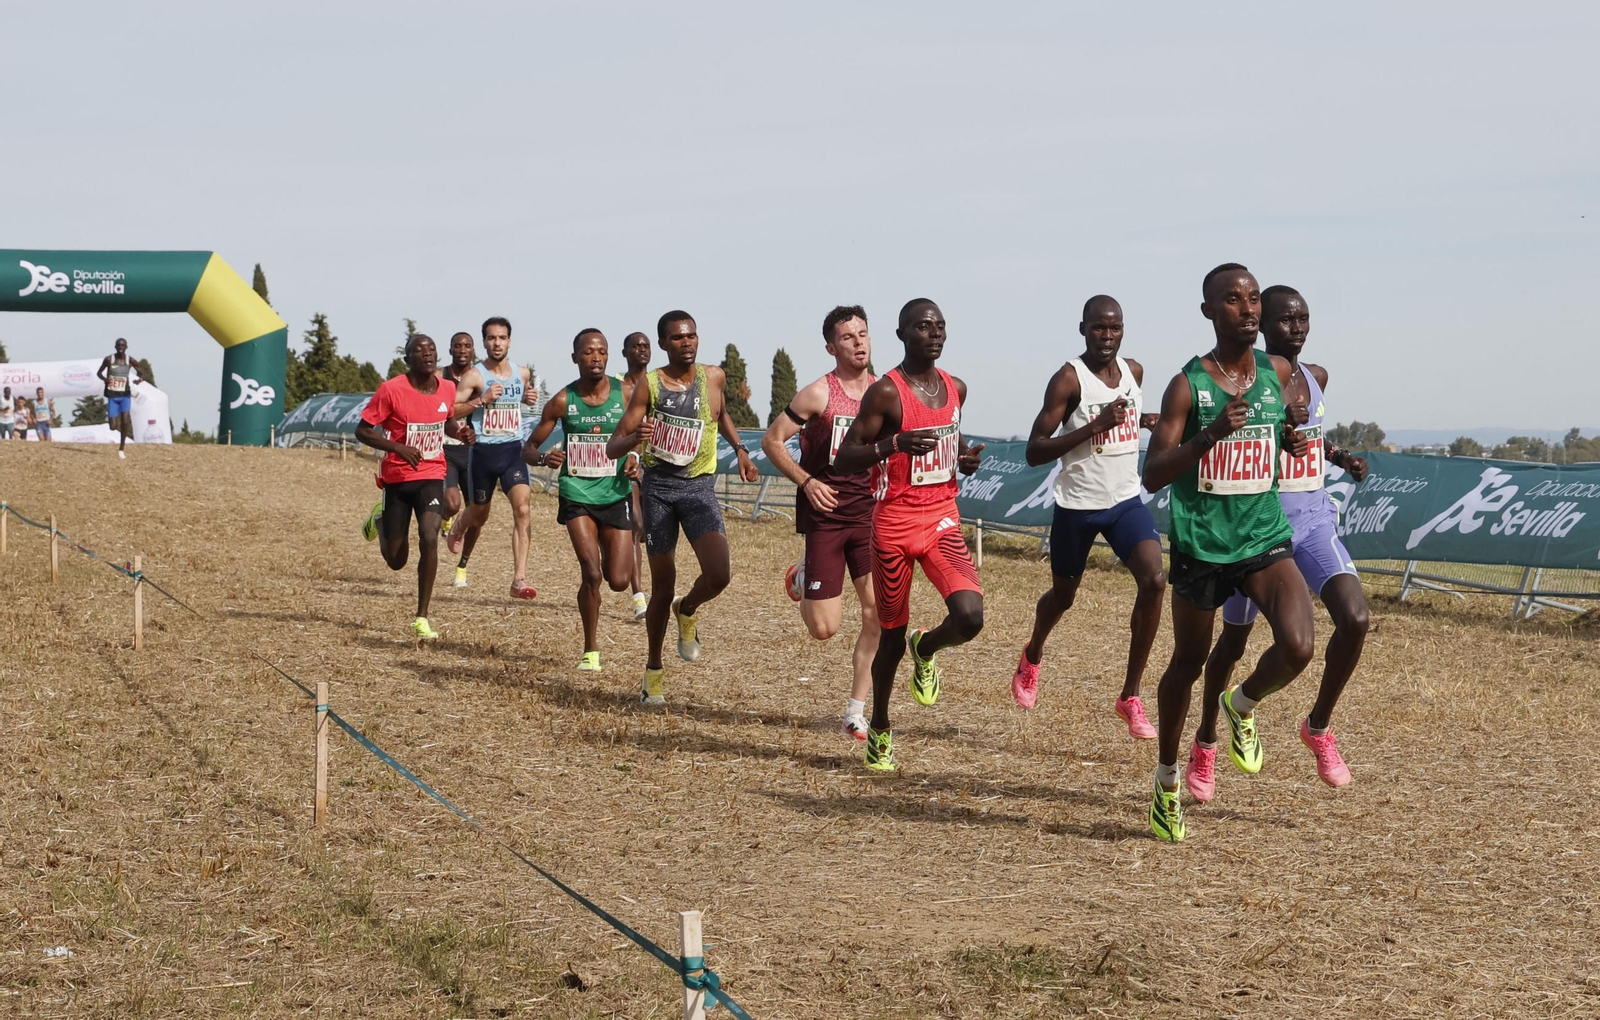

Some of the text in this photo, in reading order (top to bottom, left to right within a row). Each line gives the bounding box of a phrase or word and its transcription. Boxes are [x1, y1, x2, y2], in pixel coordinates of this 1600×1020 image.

[73, 269, 125, 281] Diputación
[73, 280, 125, 294] Sevilla
[484, 410, 519, 430] AOUINA
[1200, 439, 1272, 480] KWIZERA
[955, 474, 1005, 501] Sevilla
[1358, 473, 1429, 498] Diputación
[1337, 496, 1400, 537] Sevilla
[1490, 500, 1588, 538] Sevilla
